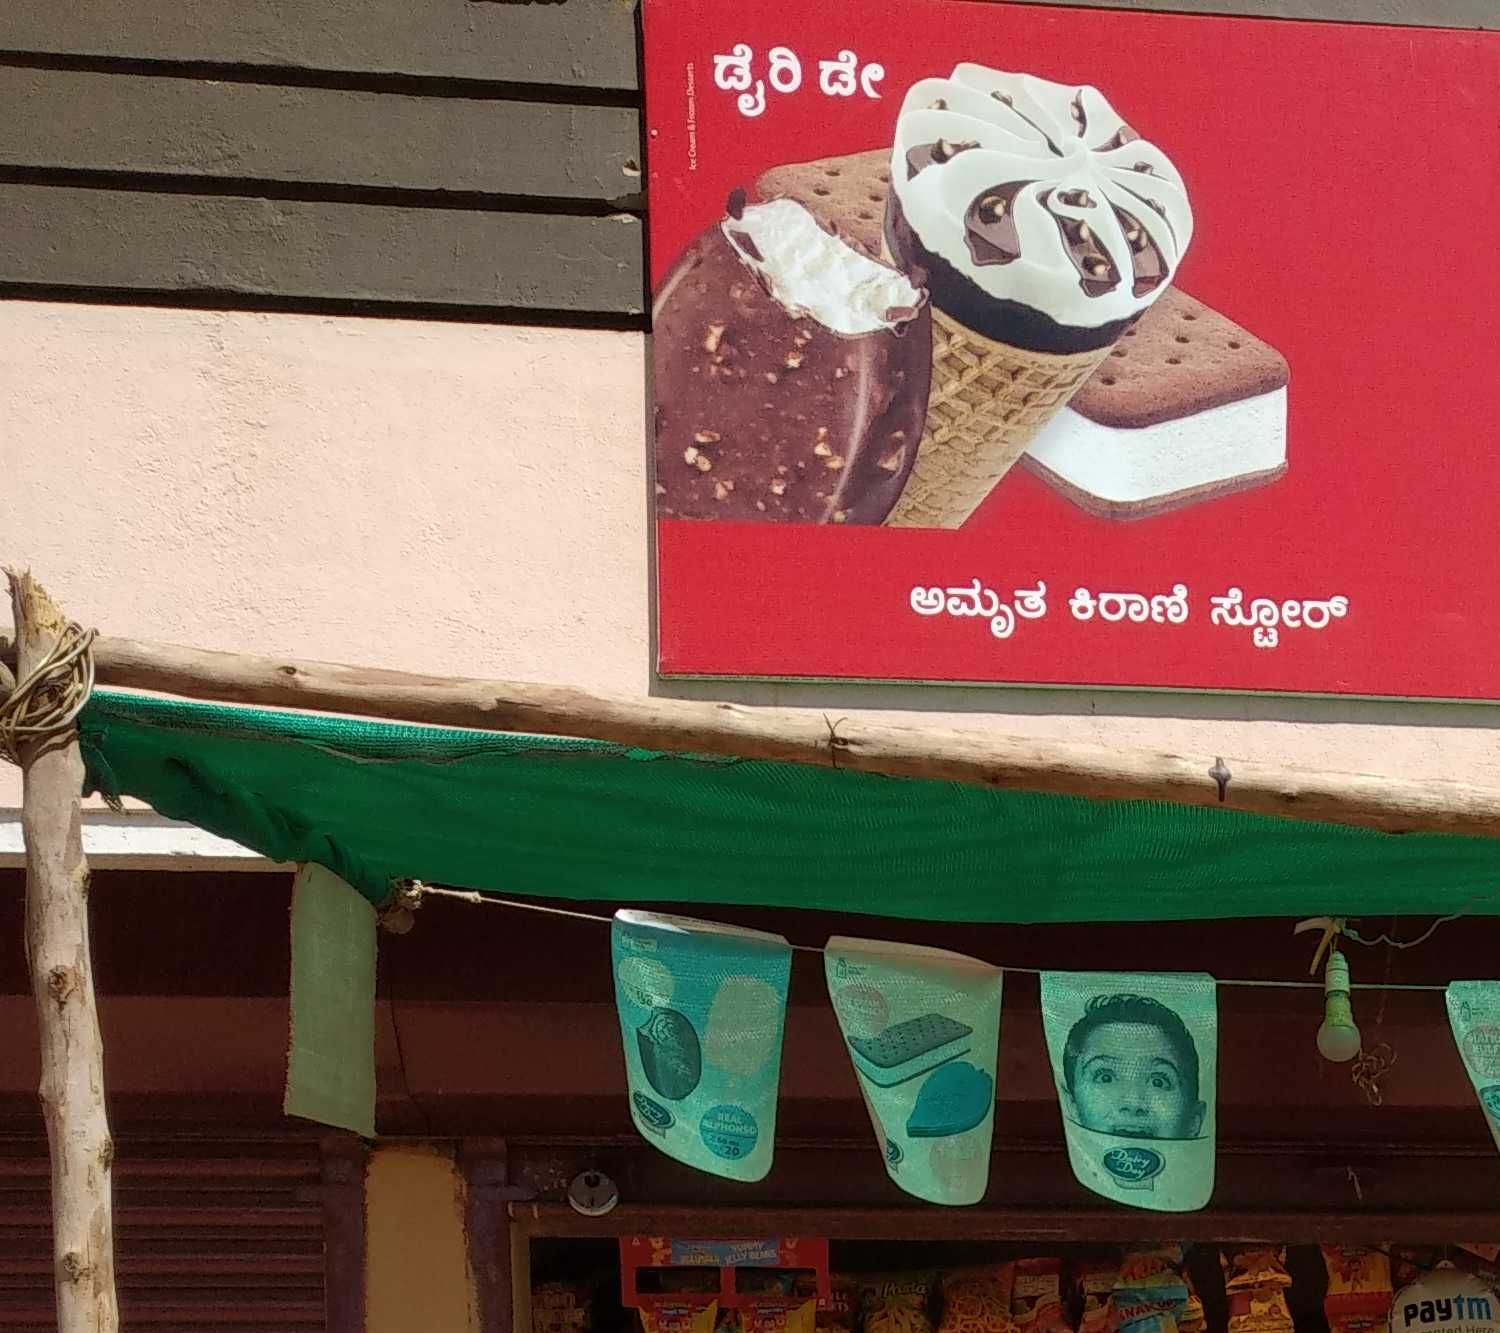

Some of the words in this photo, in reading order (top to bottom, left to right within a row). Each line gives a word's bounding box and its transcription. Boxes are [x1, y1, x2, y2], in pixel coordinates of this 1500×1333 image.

[713, 43, 803, 118] ಡೈರಿ
[818, 50, 886, 99] ಡೇ
[910, 578, 1047, 639] ಅಮೃತ
[1068, 583, 1190, 624] ಕಿರಾಣಿ
[1210, 586, 1350, 648] ಸ್ಟೋರ್
[1110, 1147, 1151, 1168] Dairy
[1117, 1161, 1146, 1180] Day
[1403, 1293, 1492, 1328] paytm
